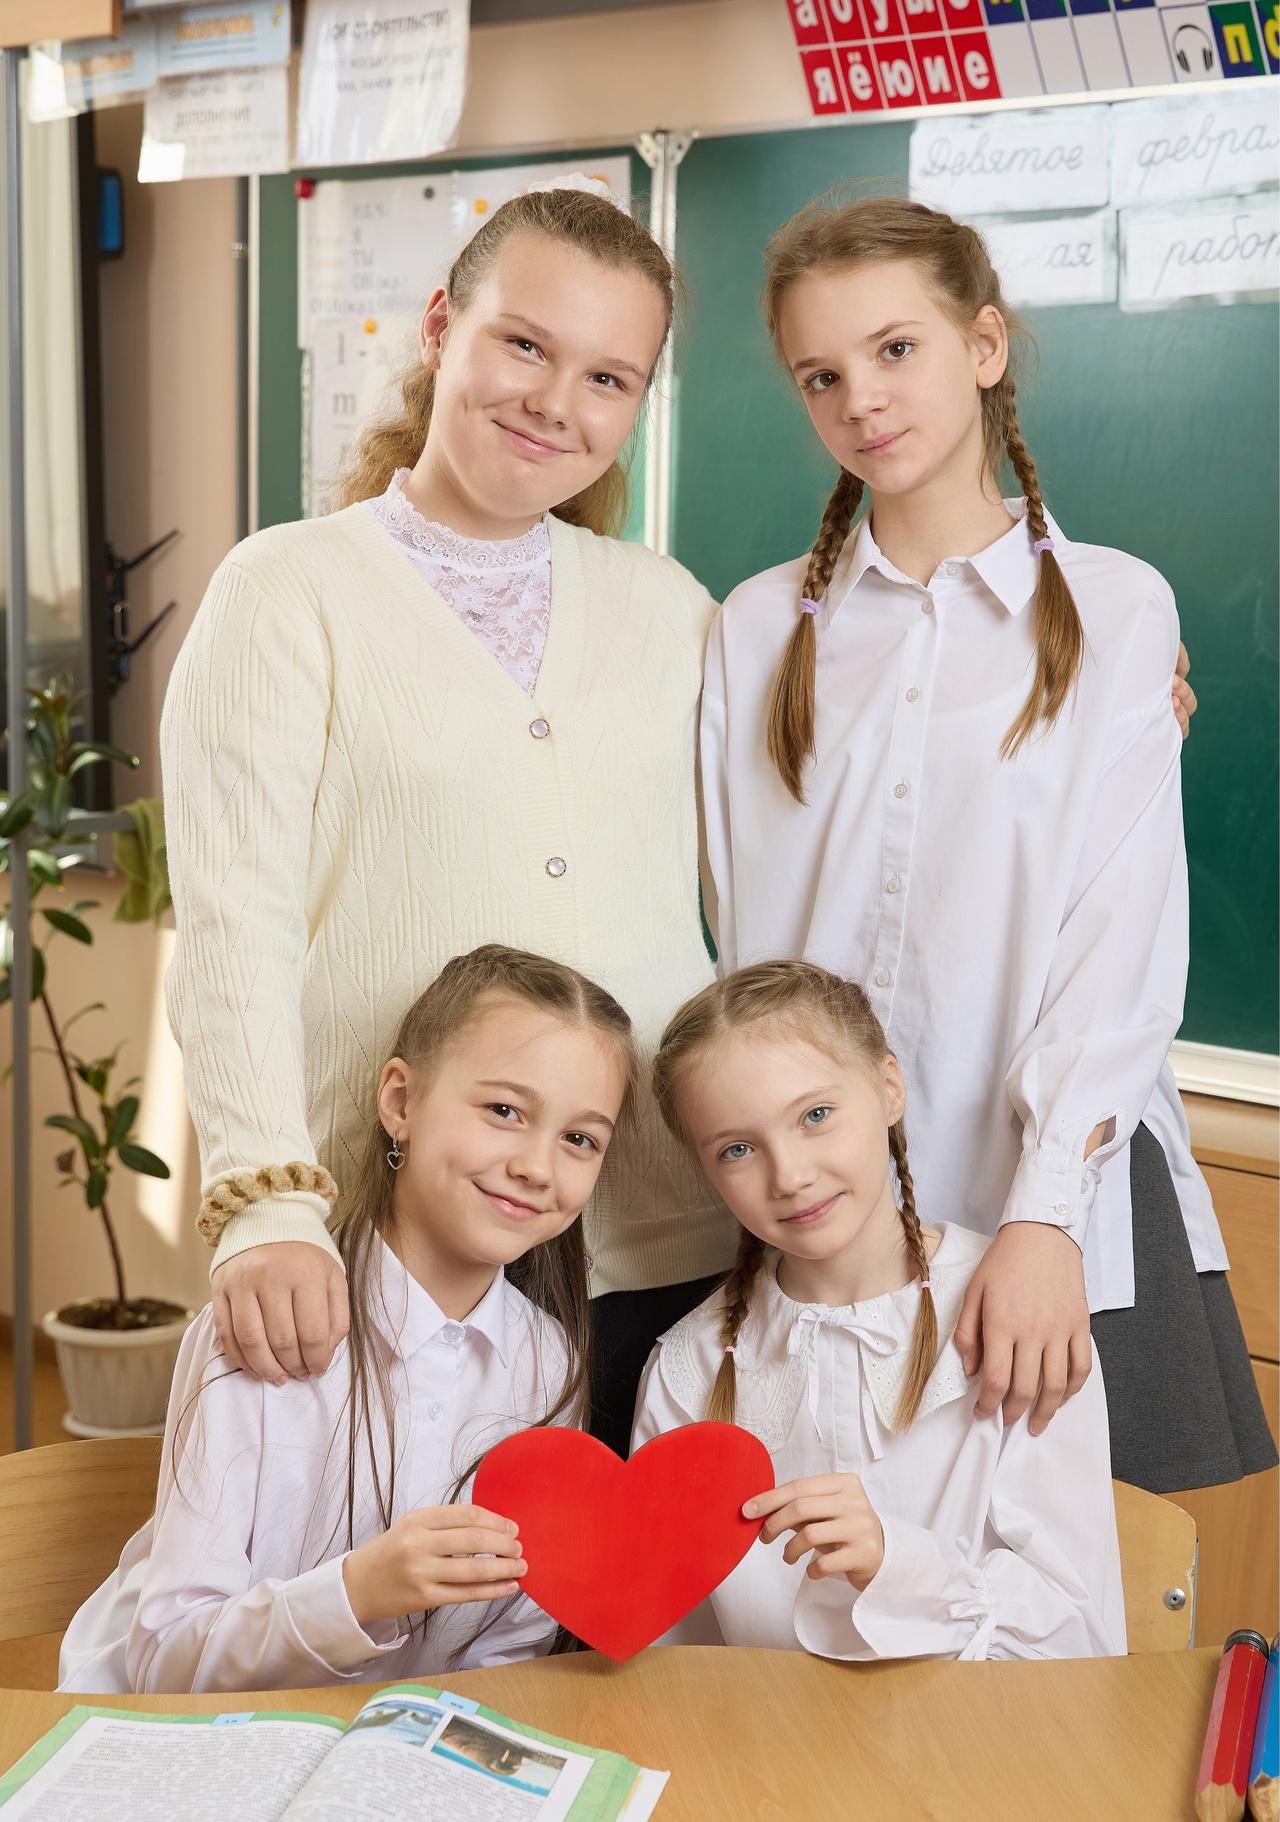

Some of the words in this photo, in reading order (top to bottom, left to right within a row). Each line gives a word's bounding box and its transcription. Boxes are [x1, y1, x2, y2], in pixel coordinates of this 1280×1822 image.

[1222, 23, 1253, 64] п
[813, 66, 838, 105] я
[847, 51, 873, 100] ё
[880, 58, 915, 98] ю
[922, 55, 951, 93] и
[964, 50, 990, 90] е
[918, 132, 1085, 179] Девятое
